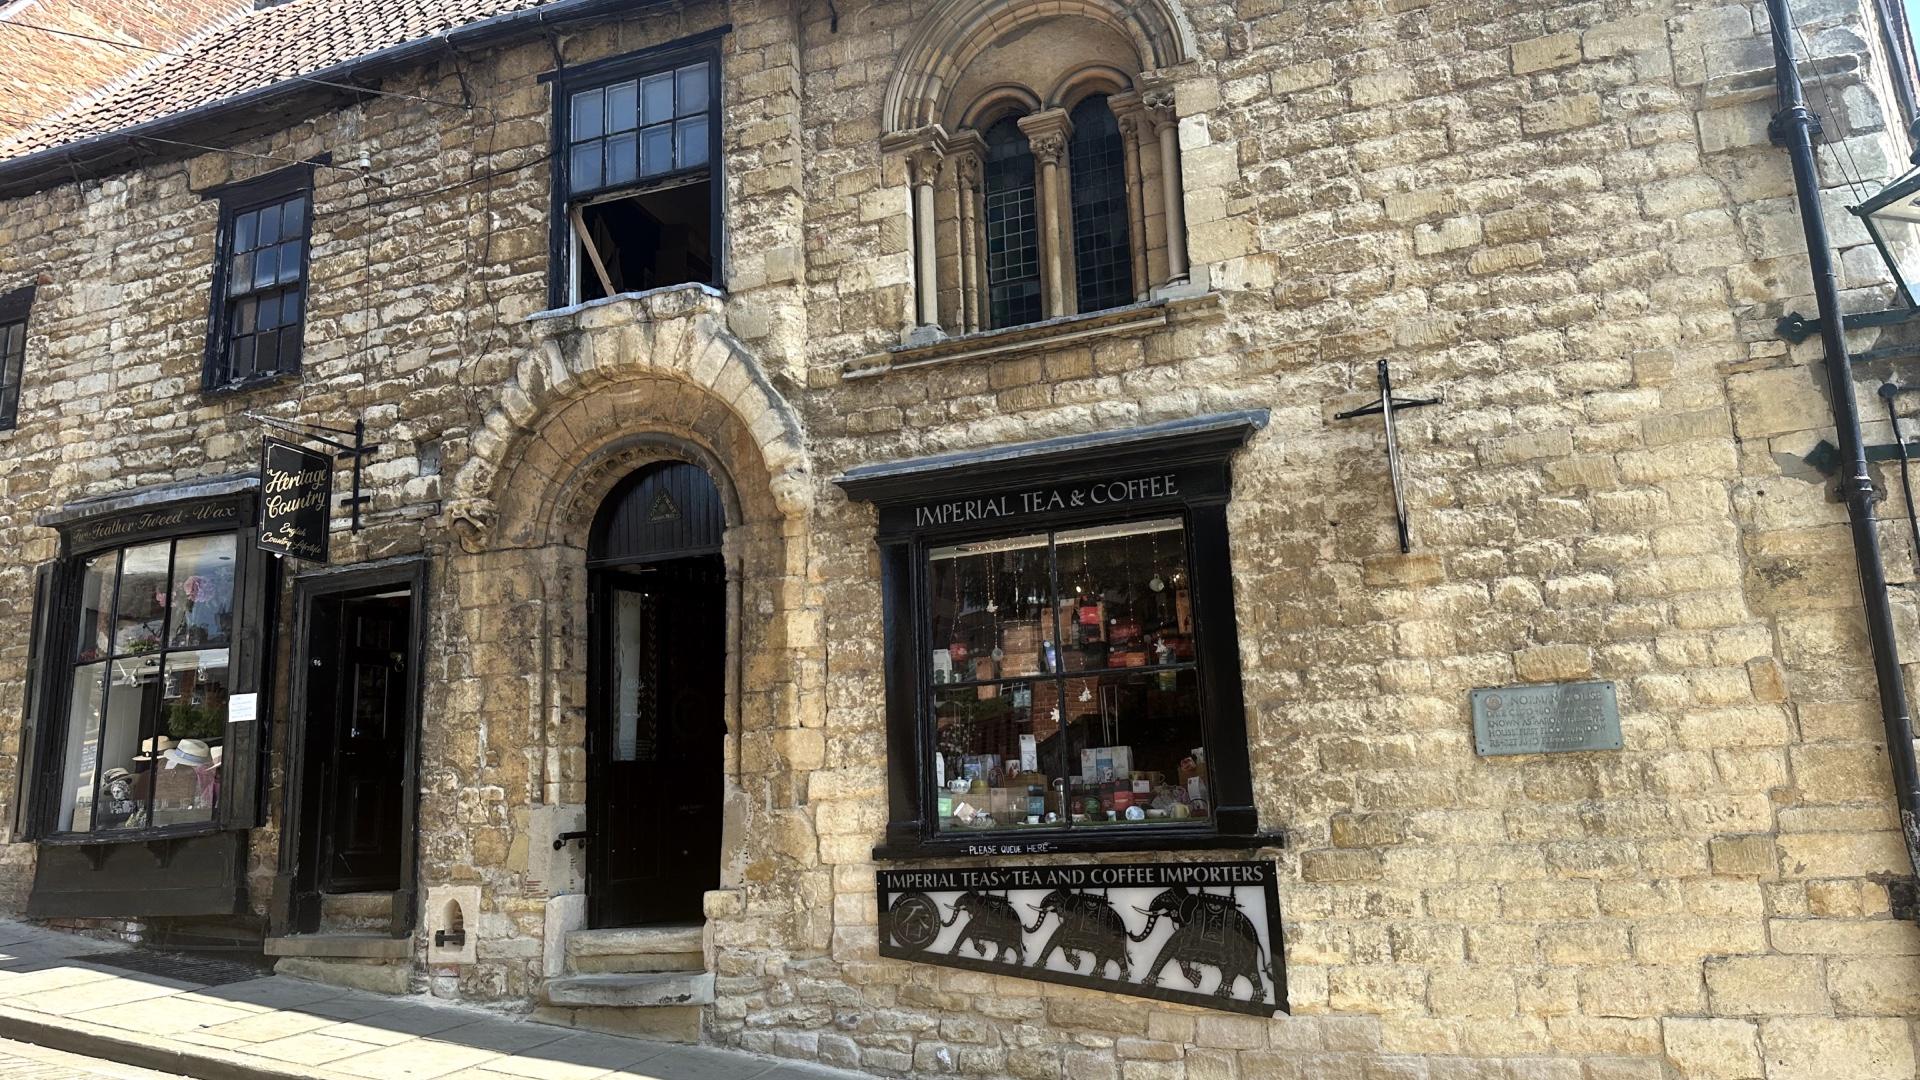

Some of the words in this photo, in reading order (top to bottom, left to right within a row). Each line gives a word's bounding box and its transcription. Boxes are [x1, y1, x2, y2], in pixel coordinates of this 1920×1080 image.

[265, 468, 327, 494] Heritage
[265, 491, 326, 518] Country
[916, 496, 1015, 527] IMPERIAL
[1020, 490, 1065, 513] TEA
[1070, 489, 1086, 507] &
[1090, 474, 1179, 504] COFFEE
[92, 518, 135, 540] Feather
[138, 510, 182, 531] Tweed
[192, 502, 236, 519] Wax
[261, 531, 292, 551] Country
[1564, 691, 1602, 702] OUSE
[1540, 725, 1566, 736] FLOO
[1571, 723, 1606, 735] WNDOW
[969, 845, 998, 855] PLEASE
[1000, 845, 1022, 854] QUEUE
[1026, 843, 1049, 853] HERE
[887, 872, 957, 889] IMPERIAL
[961, 871, 999, 887] TEAS
[1012, 870, 1043, 886] TEA
[1047, 868, 1085, 885] AND
[1090, 867, 1154, 885] COFFEE
[1160, 865, 1264, 883] IMPORTERS
